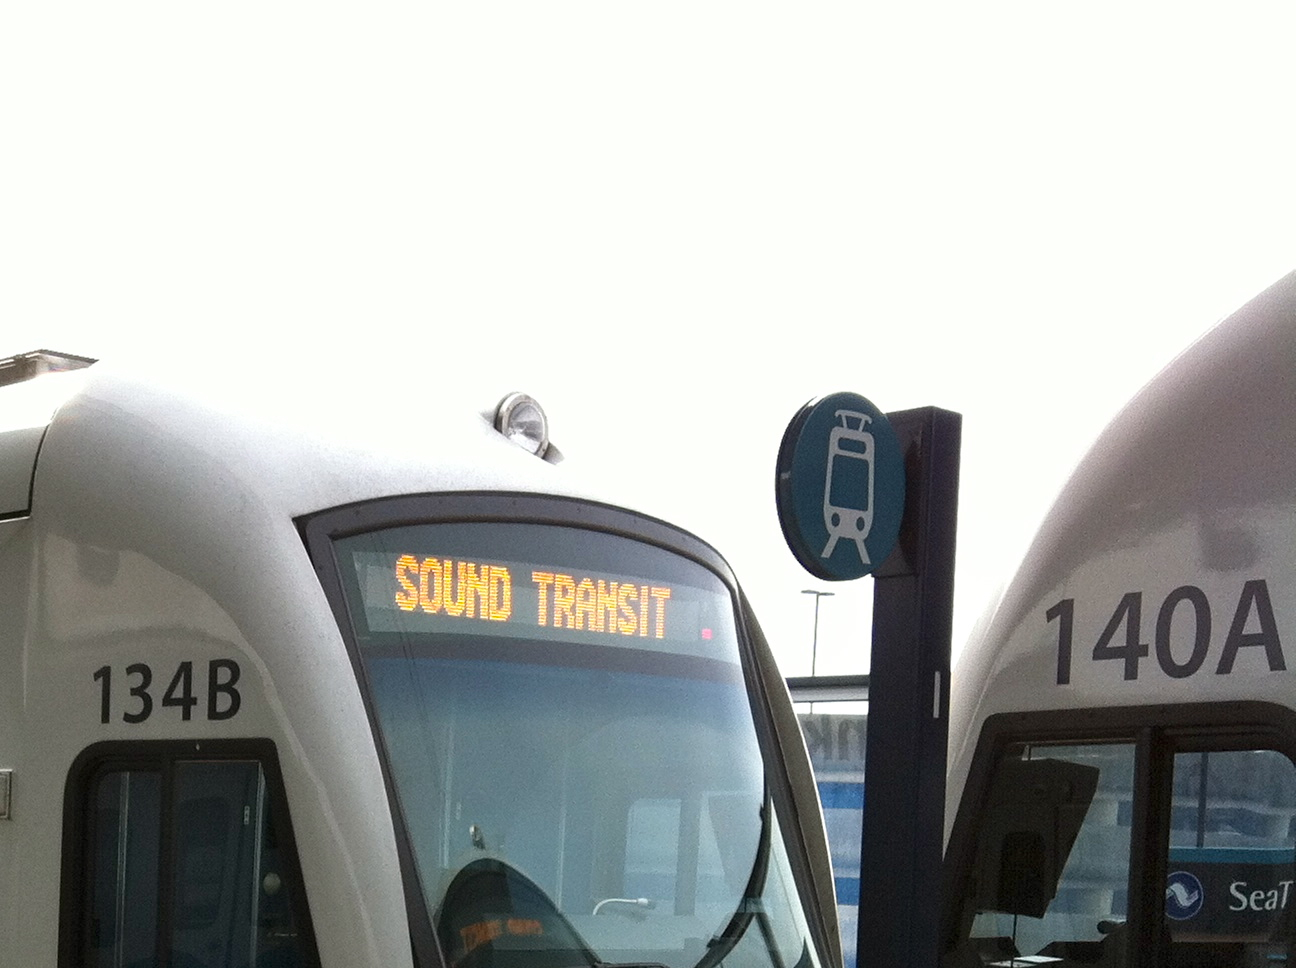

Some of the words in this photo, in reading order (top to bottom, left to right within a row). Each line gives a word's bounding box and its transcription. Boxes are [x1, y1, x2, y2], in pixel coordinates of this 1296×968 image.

[394, 554, 512, 622] SOUND
[531, 570, 671, 639] TRANSIT
[1045, 579, 1288, 686] 140A
[92, 658, 242, 724] 134B
